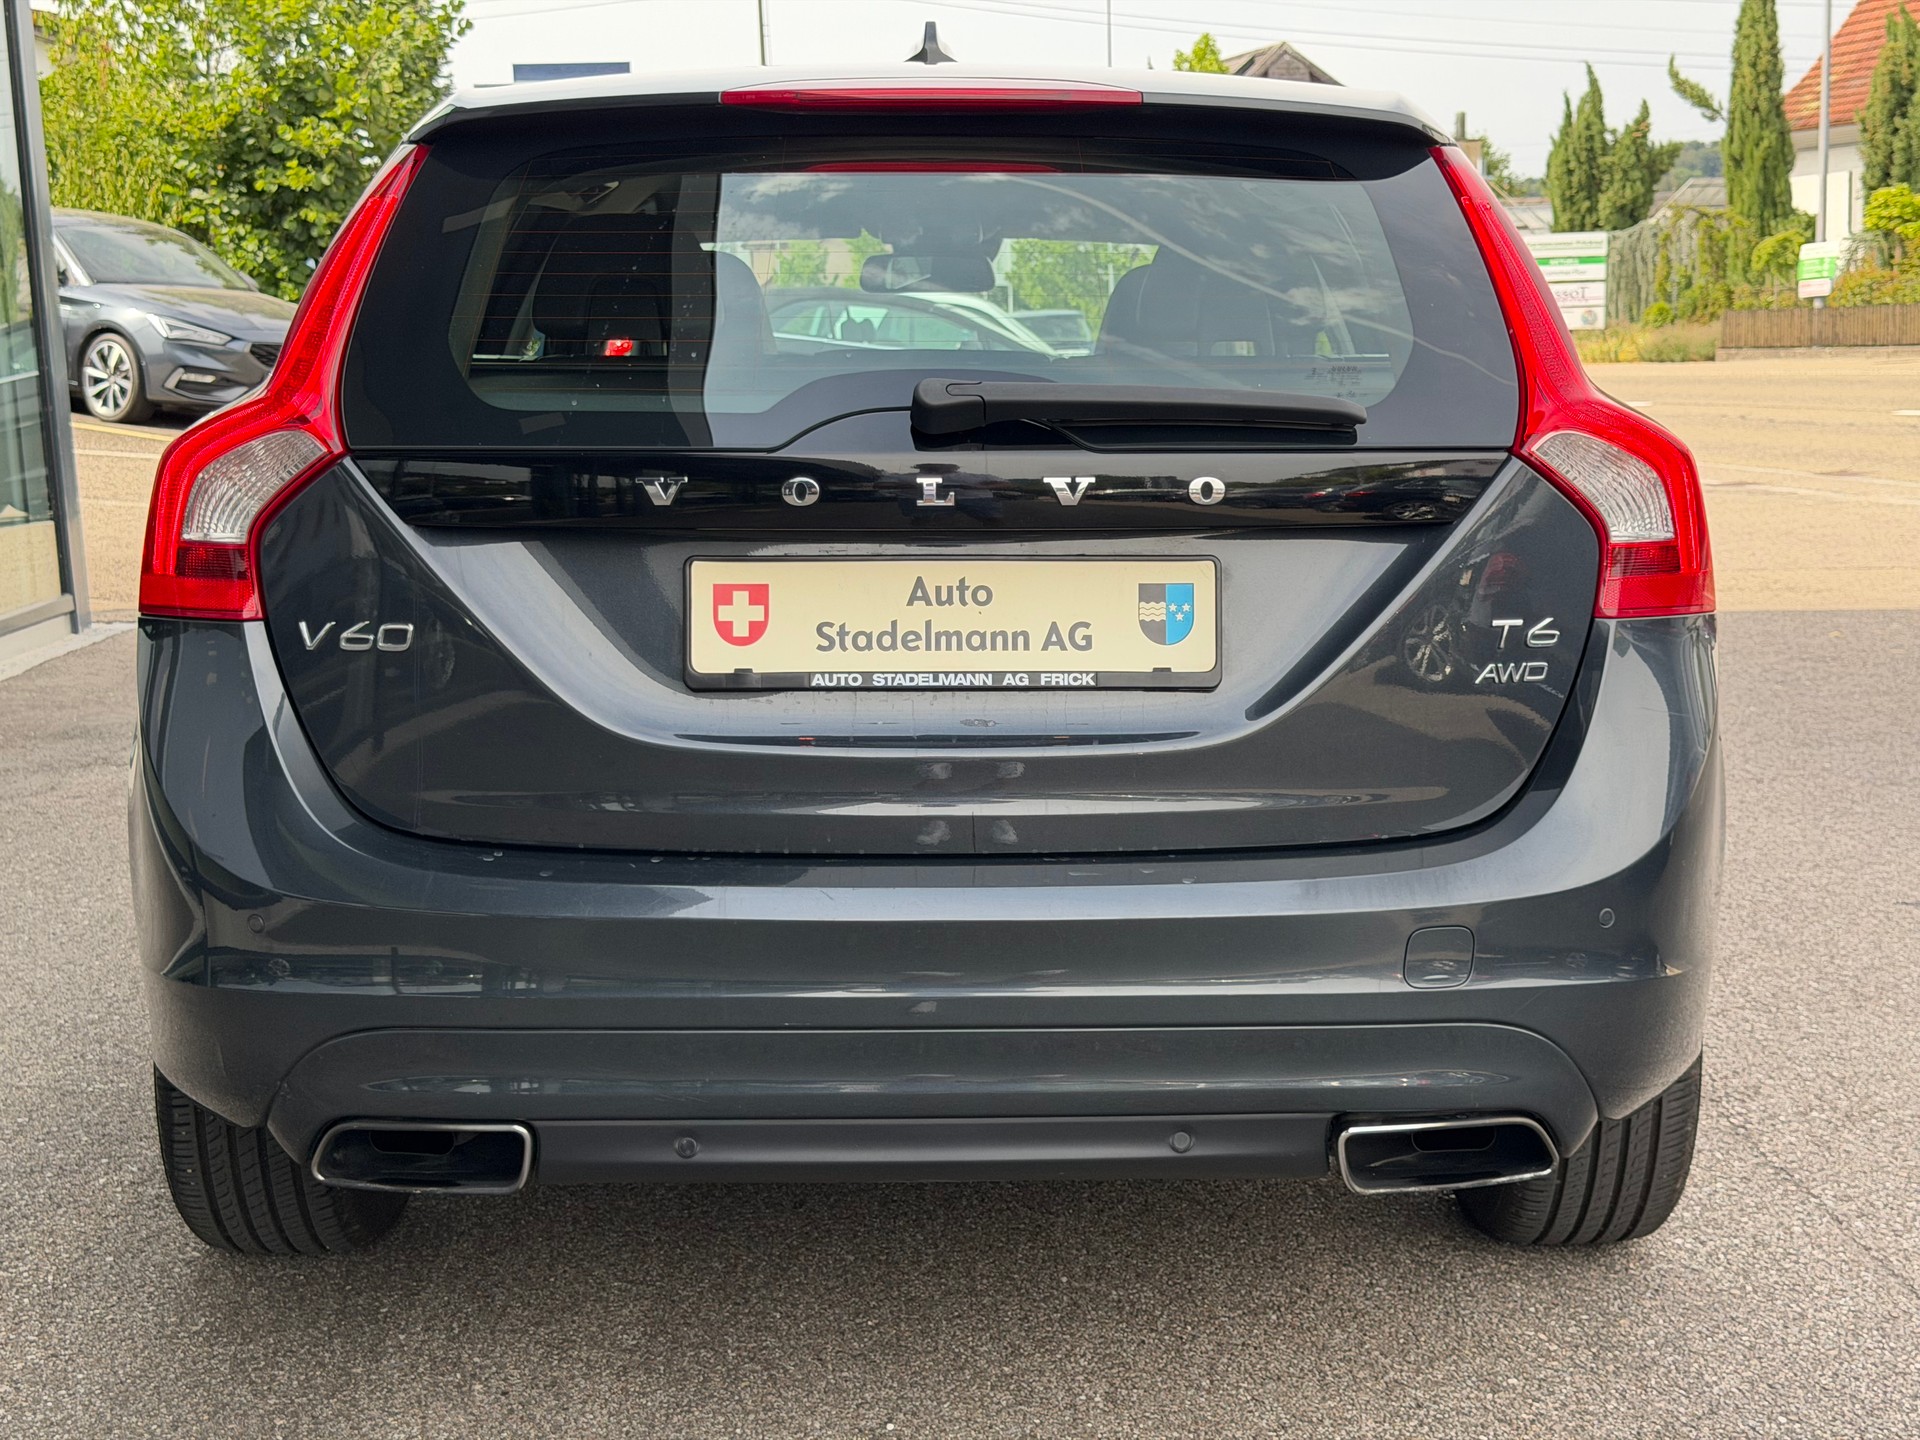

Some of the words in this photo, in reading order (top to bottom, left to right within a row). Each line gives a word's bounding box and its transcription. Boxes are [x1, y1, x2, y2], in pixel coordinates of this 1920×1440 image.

[635, 476, 1226, 506] VOLVO
[905, 575, 994, 608] Auto
[298, 620, 414, 652] V60
[815, 619, 1031, 653] Stadelmann
[1040, 621, 1093, 652] AG
[1491, 617, 1561, 649] T6
[811, 673, 863, 687] AUTO
[872, 673, 993, 687] STADELMANN
[1002, 673, 1030, 687] AG
[1040, 673, 1096, 687] FRICK
[1474, 661, 1549, 684] AWD
